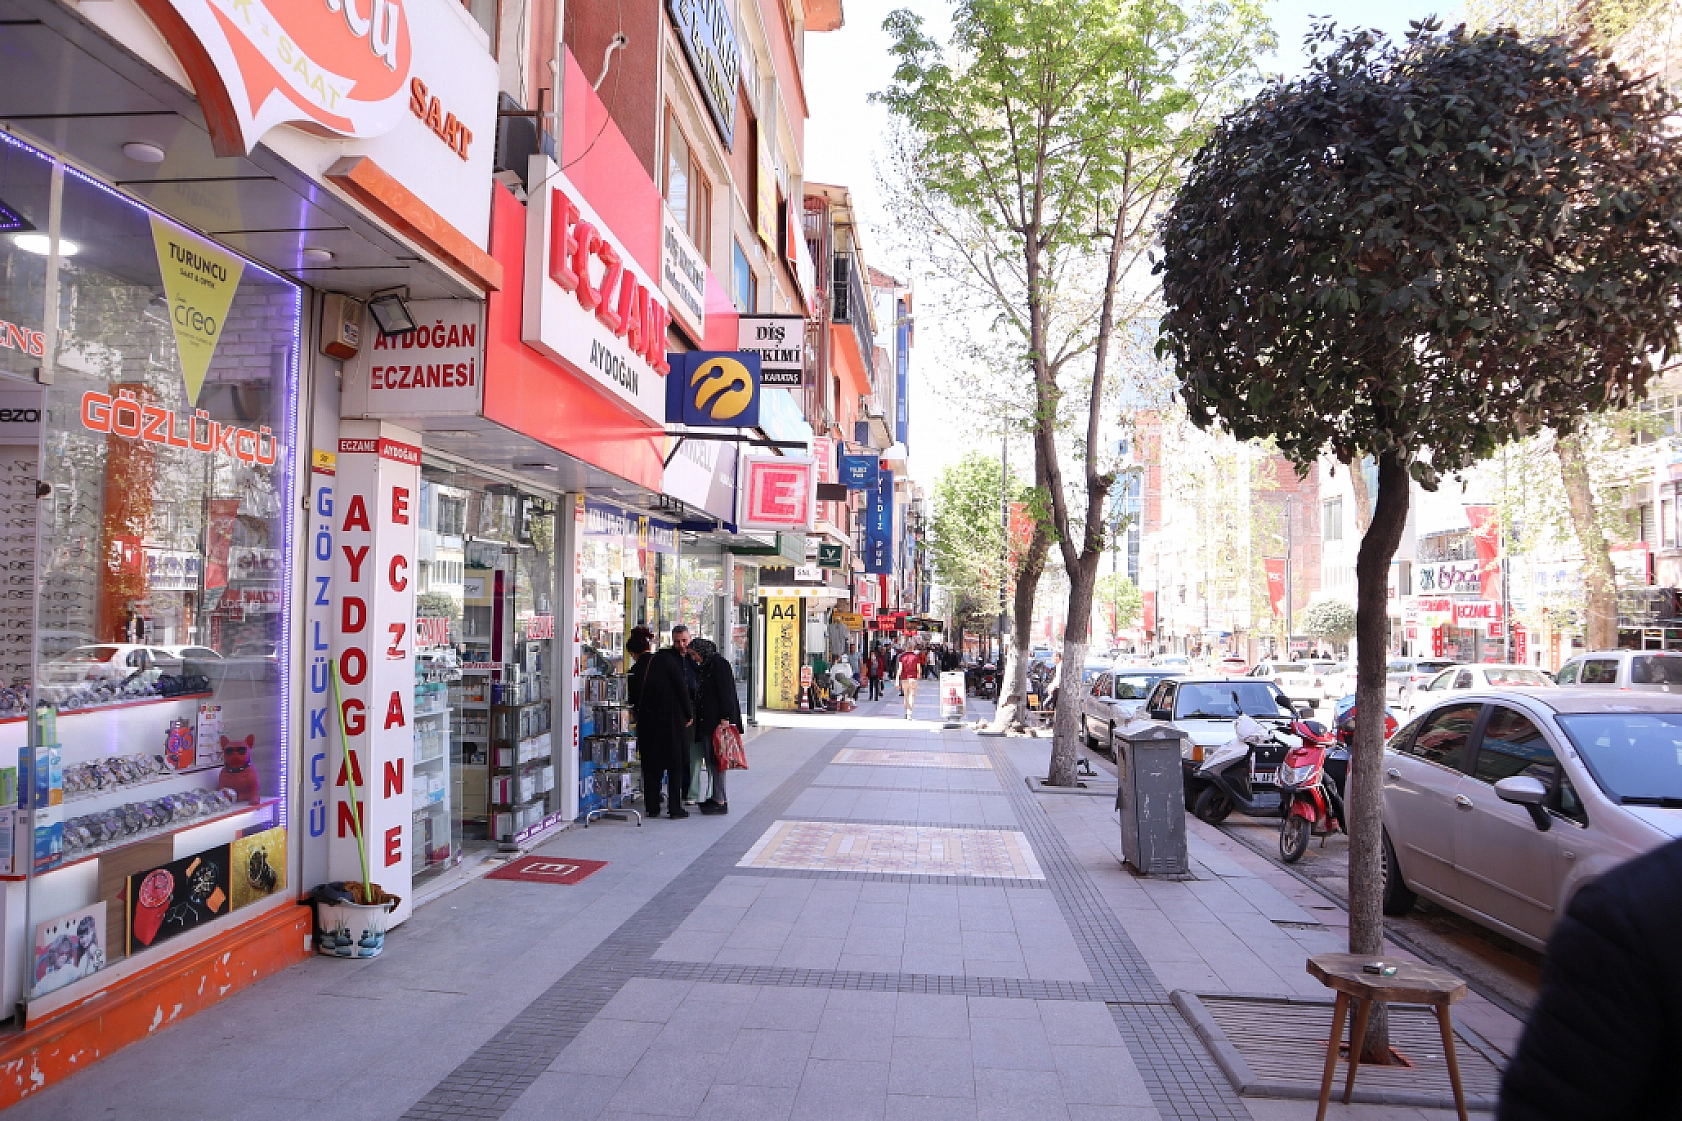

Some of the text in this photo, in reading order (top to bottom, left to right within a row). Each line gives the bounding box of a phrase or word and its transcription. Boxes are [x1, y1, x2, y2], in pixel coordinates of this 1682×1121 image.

[325, 0, 399, 72] cu
[277, 36, 341, 109] SAAT
[409, 77, 473, 162] SAAT
[168, 241, 227, 282] TURUNCU
[549, 187, 671, 377] ECZANE
[739, 345, 801, 363] KİMİ
[755, 322, 785, 343] DİŞ
[371, 357, 475, 390] ECZANESİ
[589, 338, 639, 396] AYDOĞAN
[81, 389, 277, 465] GÖZLÜKÇÜ
[341, 440, 376, 452] ECZANE
[383, 443, 418, 462] AYDOĞAN
[771, 604, 796, 620] A4
[1458, 605, 1491, 618] ECZANE
[309, 487, 333, 837] GÖZLÜKÇÜ
[384, 485, 410, 868] ECZANE
